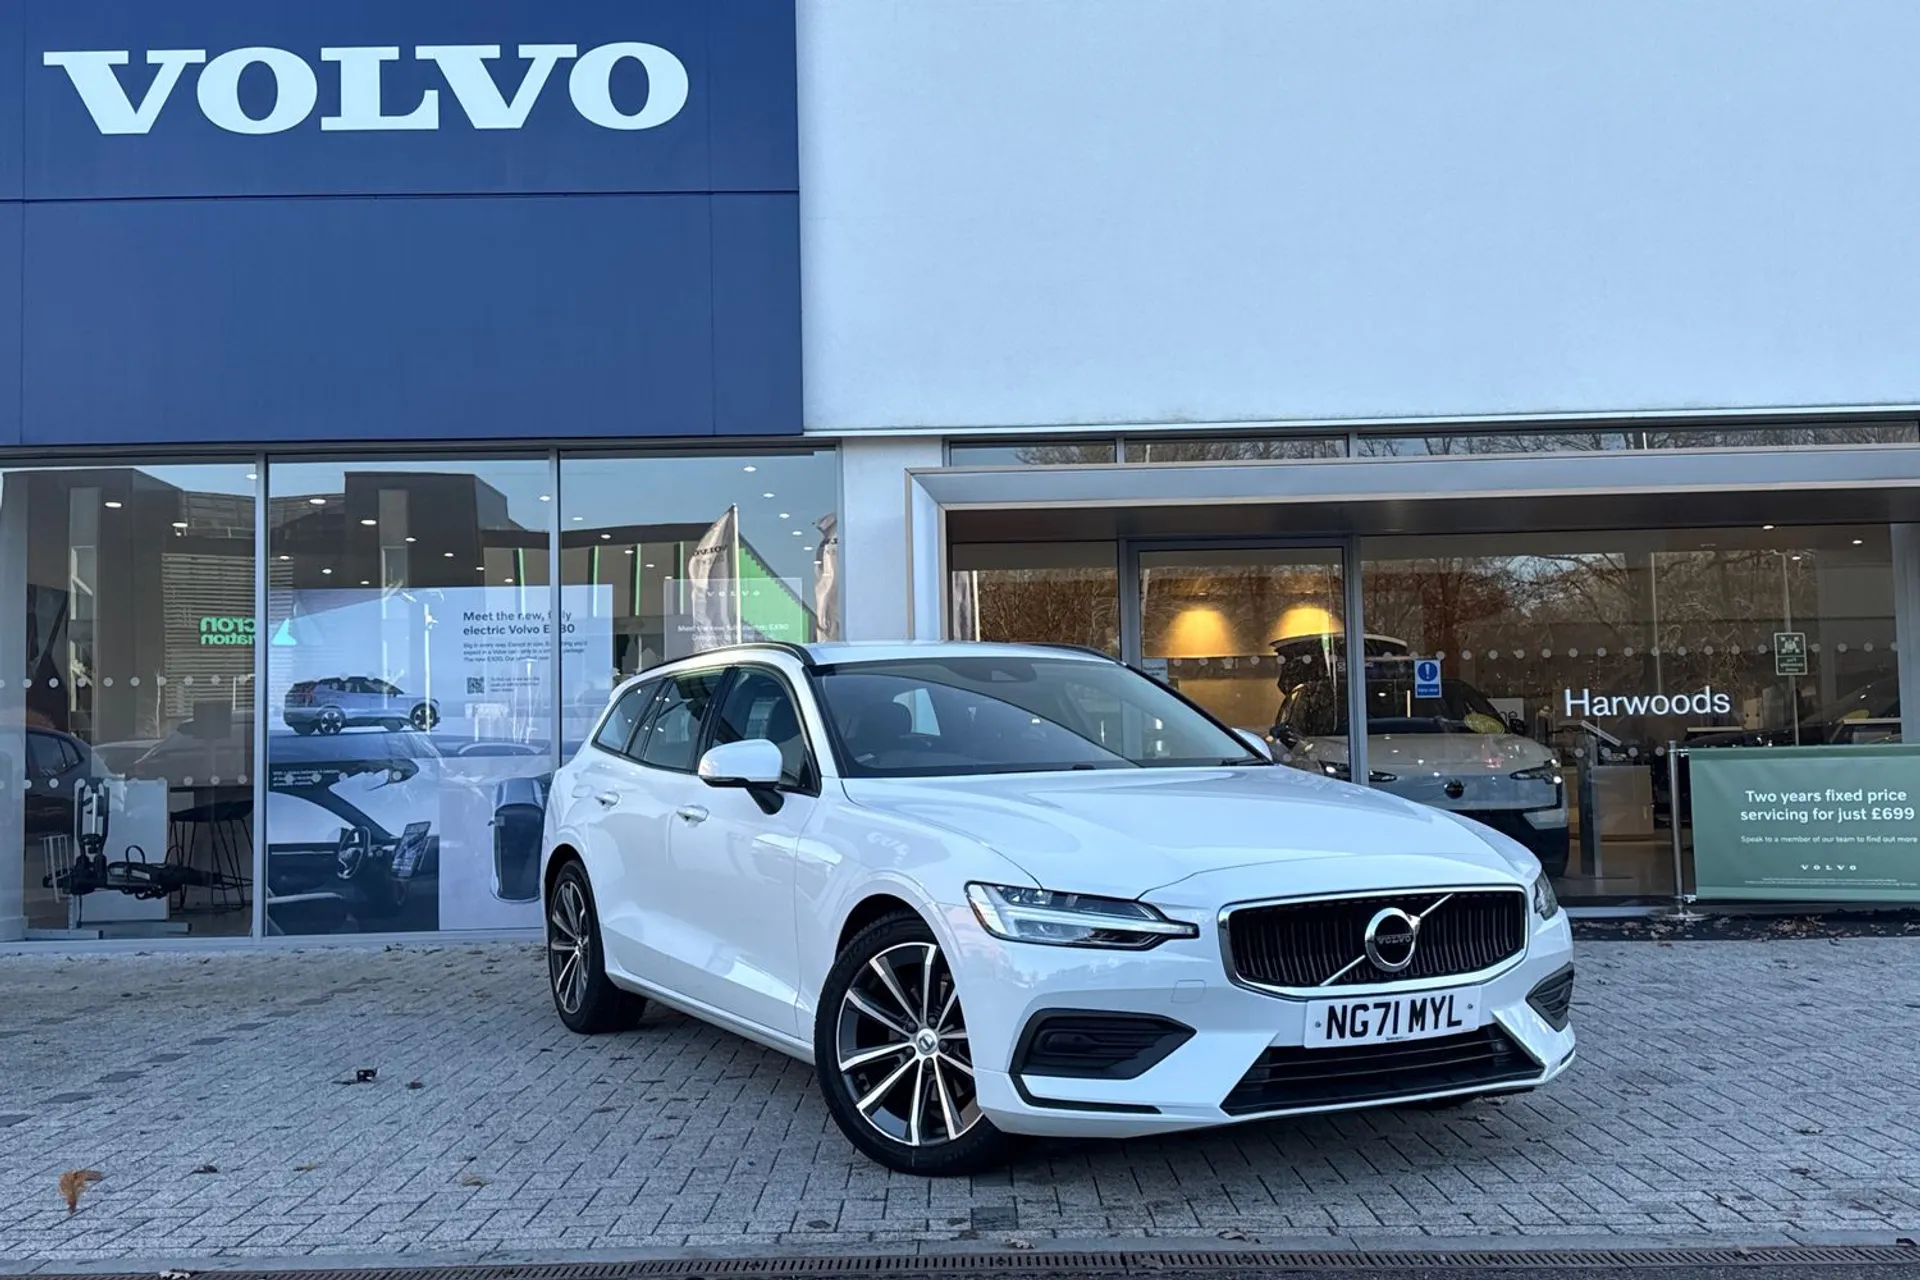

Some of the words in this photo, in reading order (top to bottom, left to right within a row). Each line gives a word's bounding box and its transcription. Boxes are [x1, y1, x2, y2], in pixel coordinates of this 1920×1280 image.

[43, 42, 689, 135] VOLVO
[462, 612, 493, 621] Meet
[496, 611, 514, 621] the
[462, 624, 506, 635] electric
[508, 624, 540, 634] Volvo
[543, 623, 576, 634] E30
[1564, 685, 1731, 717] Harwoods
[1744, 790, 1777, 803] Two
[1780, 791, 1822, 805] years
[1825, 789, 1863, 802] fixed
[1867, 789, 1907, 804] price
[1740, 808, 1809, 823] servicing
[1812, 807, 1834, 821] for
[1837, 807, 1867, 823] just
[1871, 807, 1915, 821] £699
[1741, 835, 1763, 844] Speak
[1780, 835, 1811, 843] member
[1812, 835, 1820, 843] of
[1866, 835, 1882, 843] find
[1375, 934, 1412, 945] VOLVO
[1326, 1001, 1400, 1040] NG71
[1408, 994, 1463, 1033] MYL
